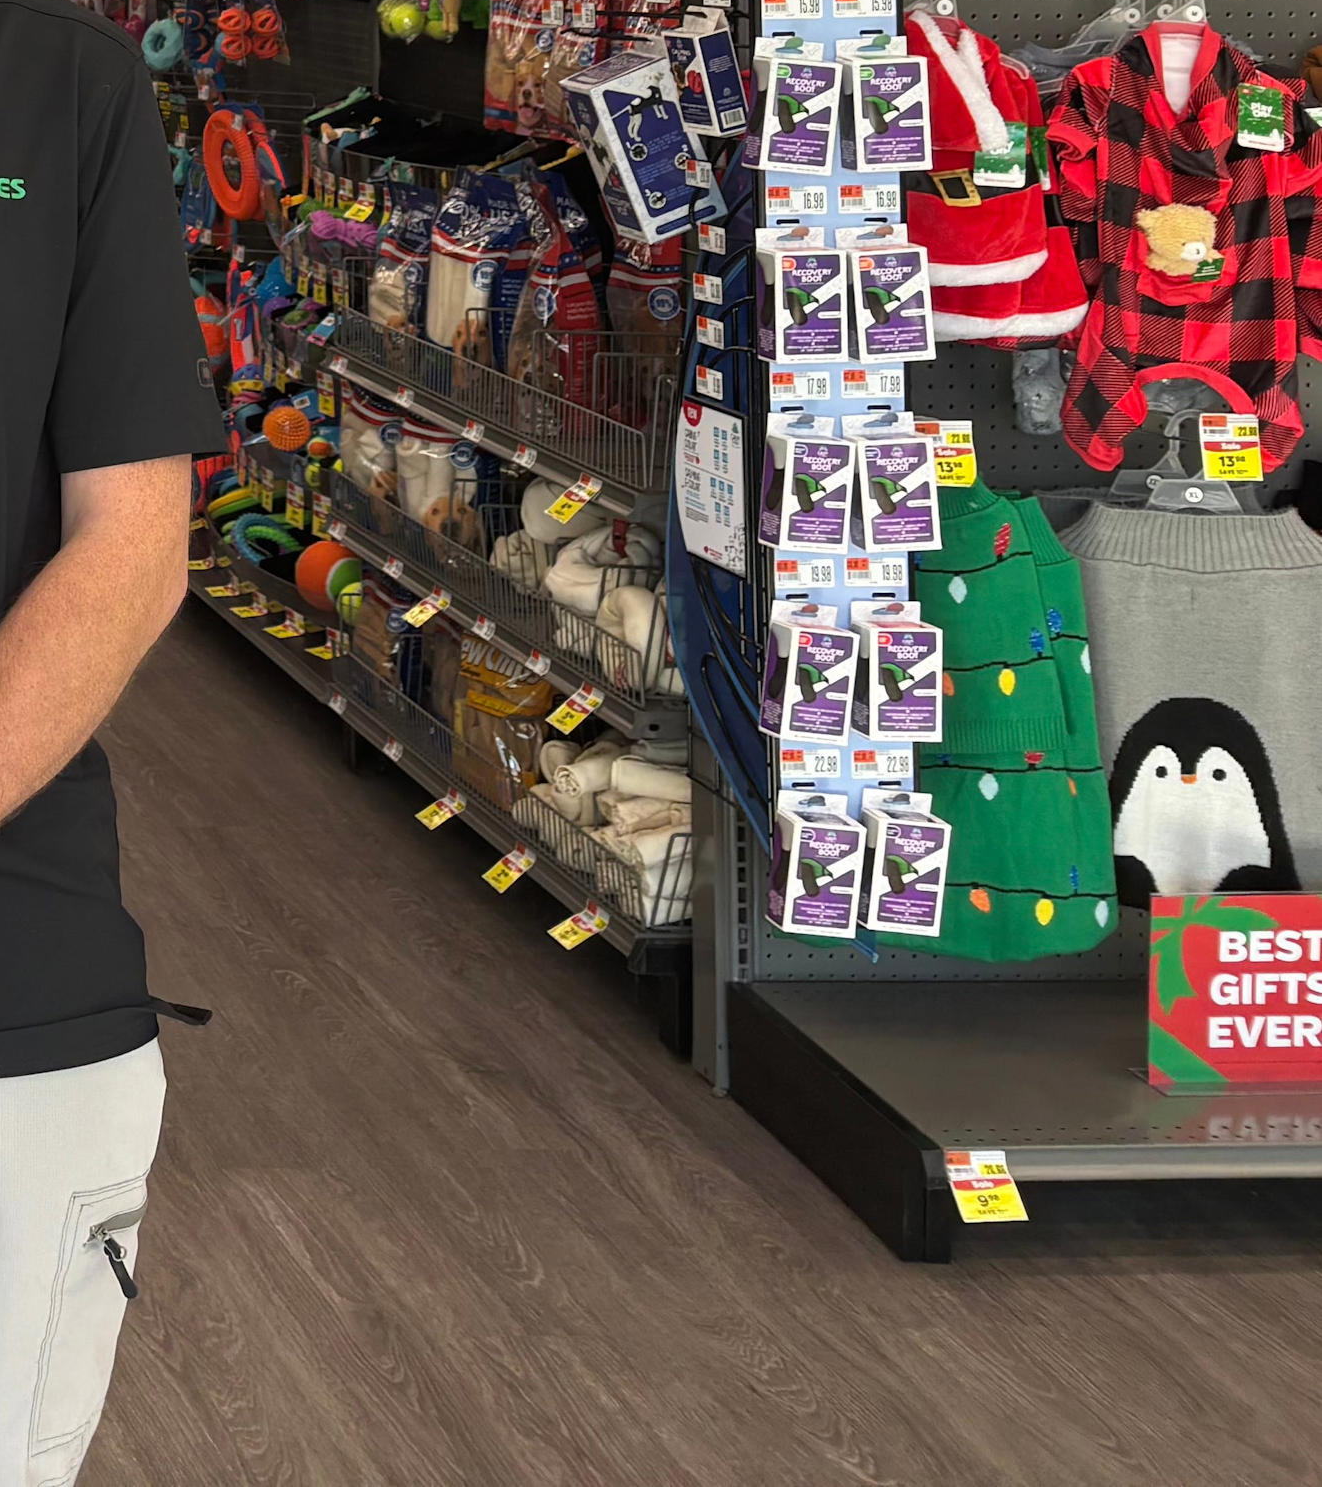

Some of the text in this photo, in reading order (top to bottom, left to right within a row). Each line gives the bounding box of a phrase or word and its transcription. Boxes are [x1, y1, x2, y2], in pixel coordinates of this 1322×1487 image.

[1219, 930, 1322, 962] BEST
[1210, 973, 1322, 1006] GIFTS
[1208, 1016, 1322, 1048] EVER
